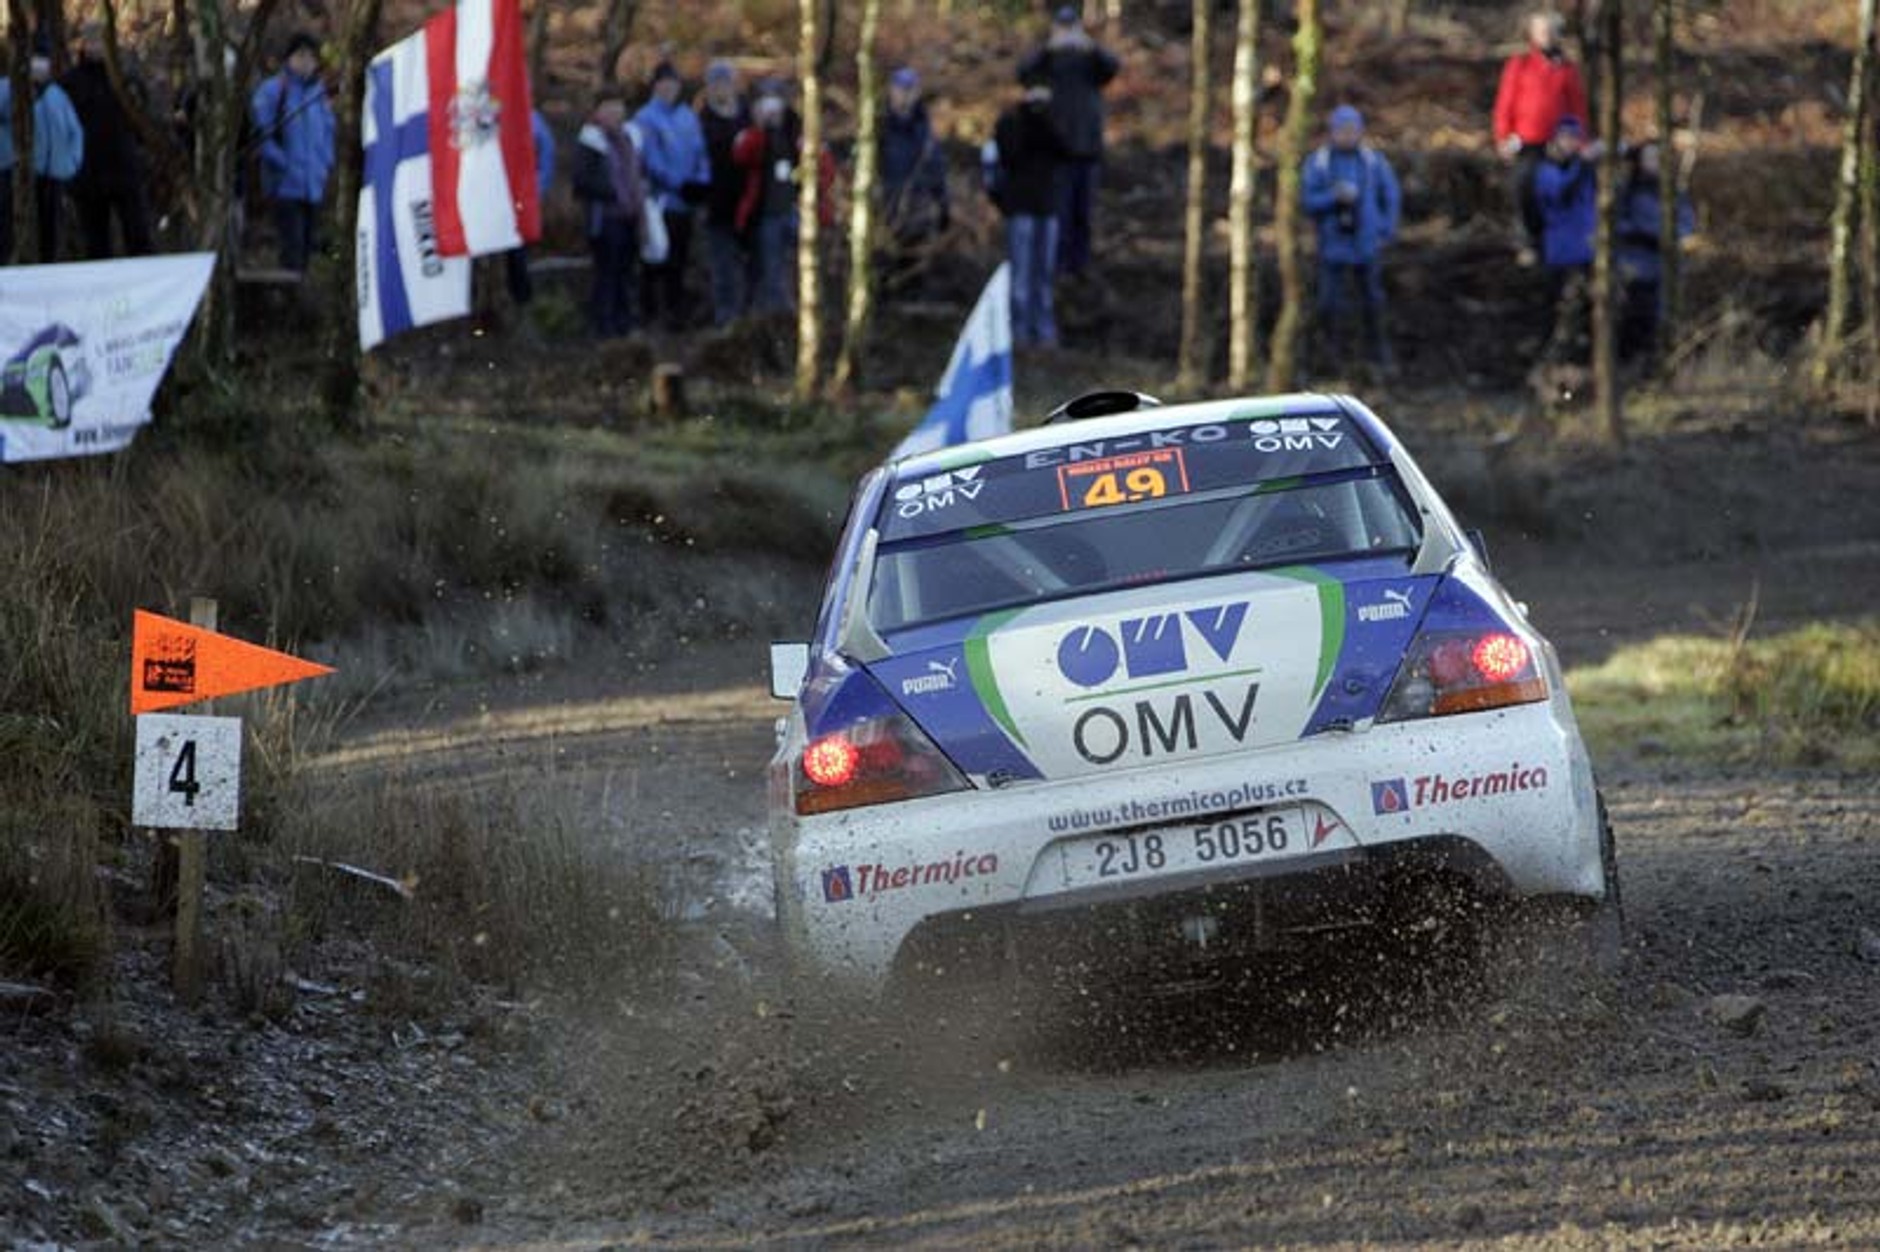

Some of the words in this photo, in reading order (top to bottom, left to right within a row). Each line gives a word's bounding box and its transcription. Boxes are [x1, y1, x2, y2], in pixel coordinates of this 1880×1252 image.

[1025, 425, 1228, 470] EN-KO
[1255, 434, 1343, 453] OMV
[899, 481, 984, 518] OMV
[1084, 467, 1166, 507] 49
[1073, 683, 1260, 765] OMV
[170, 740, 200, 807] 4
[1414, 762, 1548, 806] Thermica
[1049, 778, 1309, 832] www.thermicaplus.cz
[1095, 833, 1166, 877] 2J8
[1194, 815, 1288, 862] 5056
[856, 851, 998, 894] Thermica
